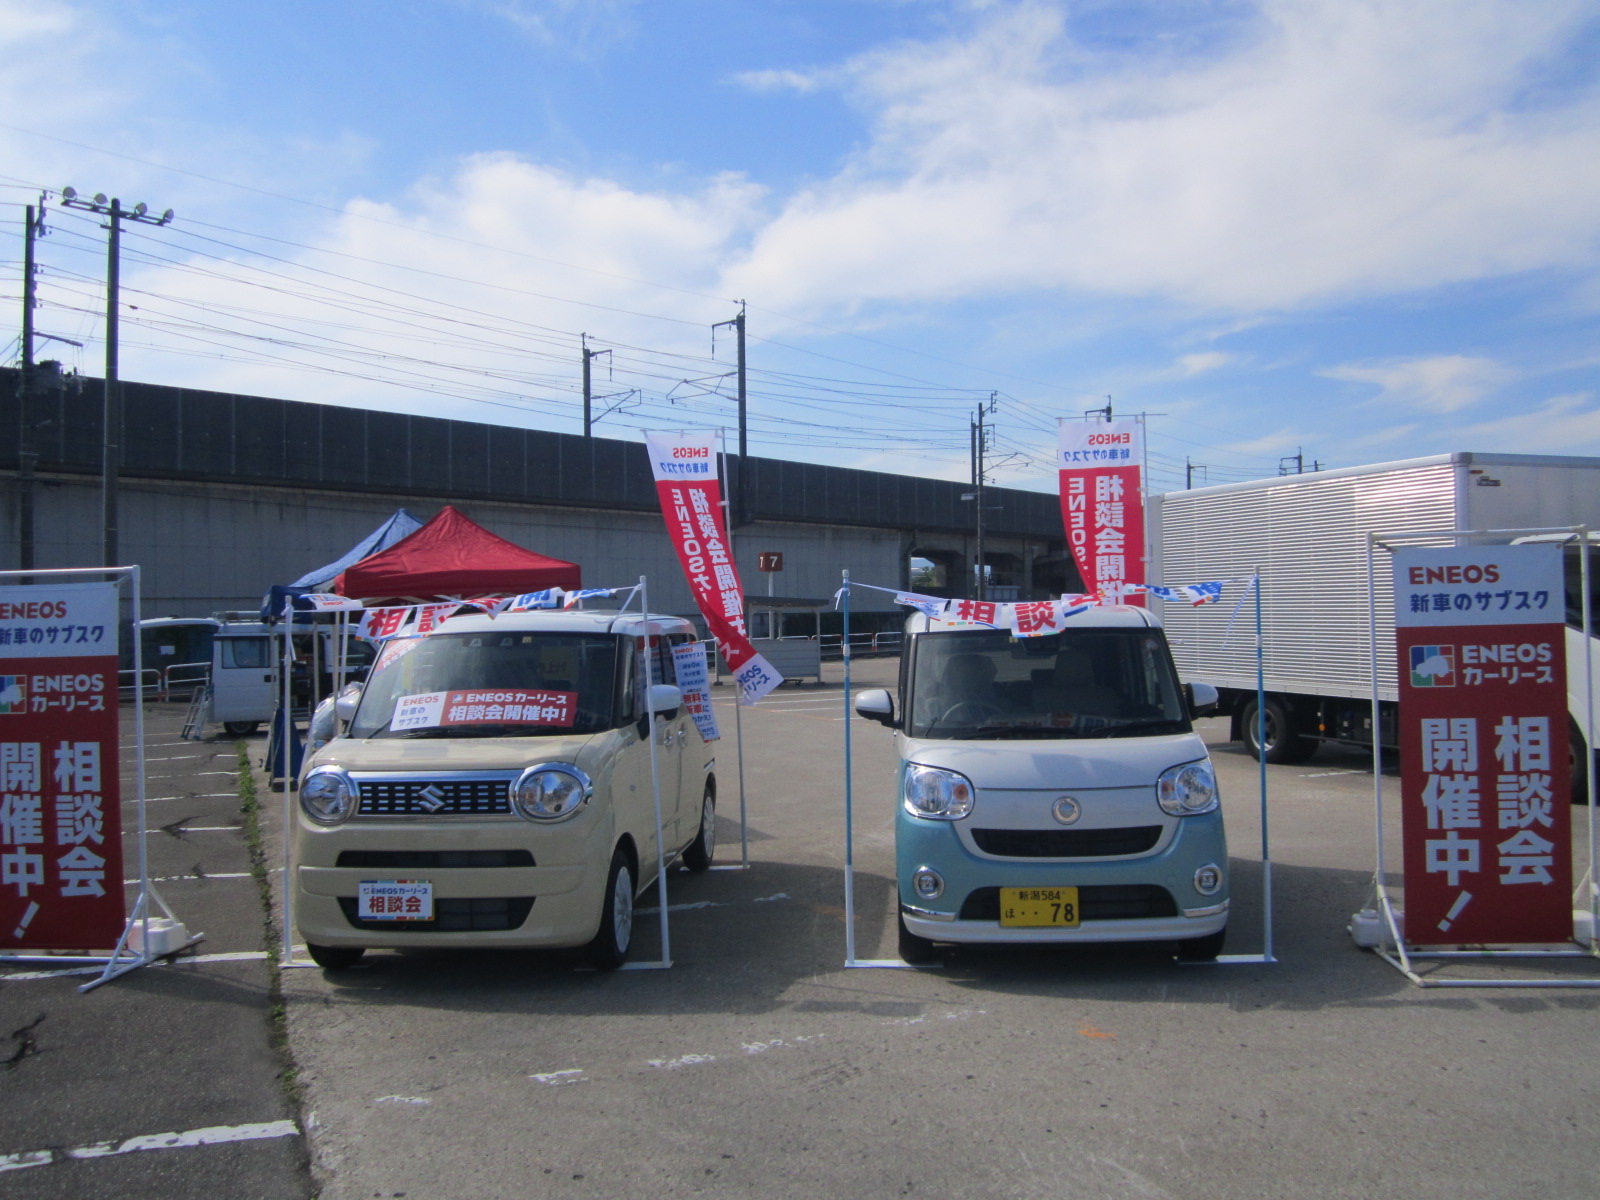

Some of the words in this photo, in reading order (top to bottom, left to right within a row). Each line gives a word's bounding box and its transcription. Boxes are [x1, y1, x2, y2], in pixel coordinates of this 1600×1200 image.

[1408, 563, 1500, 585] ENEOS
[0, 601, 67, 620] ENEOS
[1410, 590, 1550, 613] 新車のサブスク
[368, 608, 407, 637] 相
[957, 600, 997, 624] 相
[1015, 603, 1056, 633] 談
[0, 625, 104, 646] 新車のサブスク
[1462, 643, 1552, 664] ENEOS
[32, 673, 104, 693] ENEOS
[1463, 665, 1554, 686] カーリース
[32, 695, 105, 713] カーリース
[402, 695, 440, 707] ENEOS
[449, 704, 567, 722] 相談会開催中!
[1494, 716, 1555, 886] 相談会
[54, 740, 107, 898] 相談会
[369, 896, 422, 913] 相談会
[1005, 908, 1016, 919] ほ
[1050, 903, 1074, 922] 78
